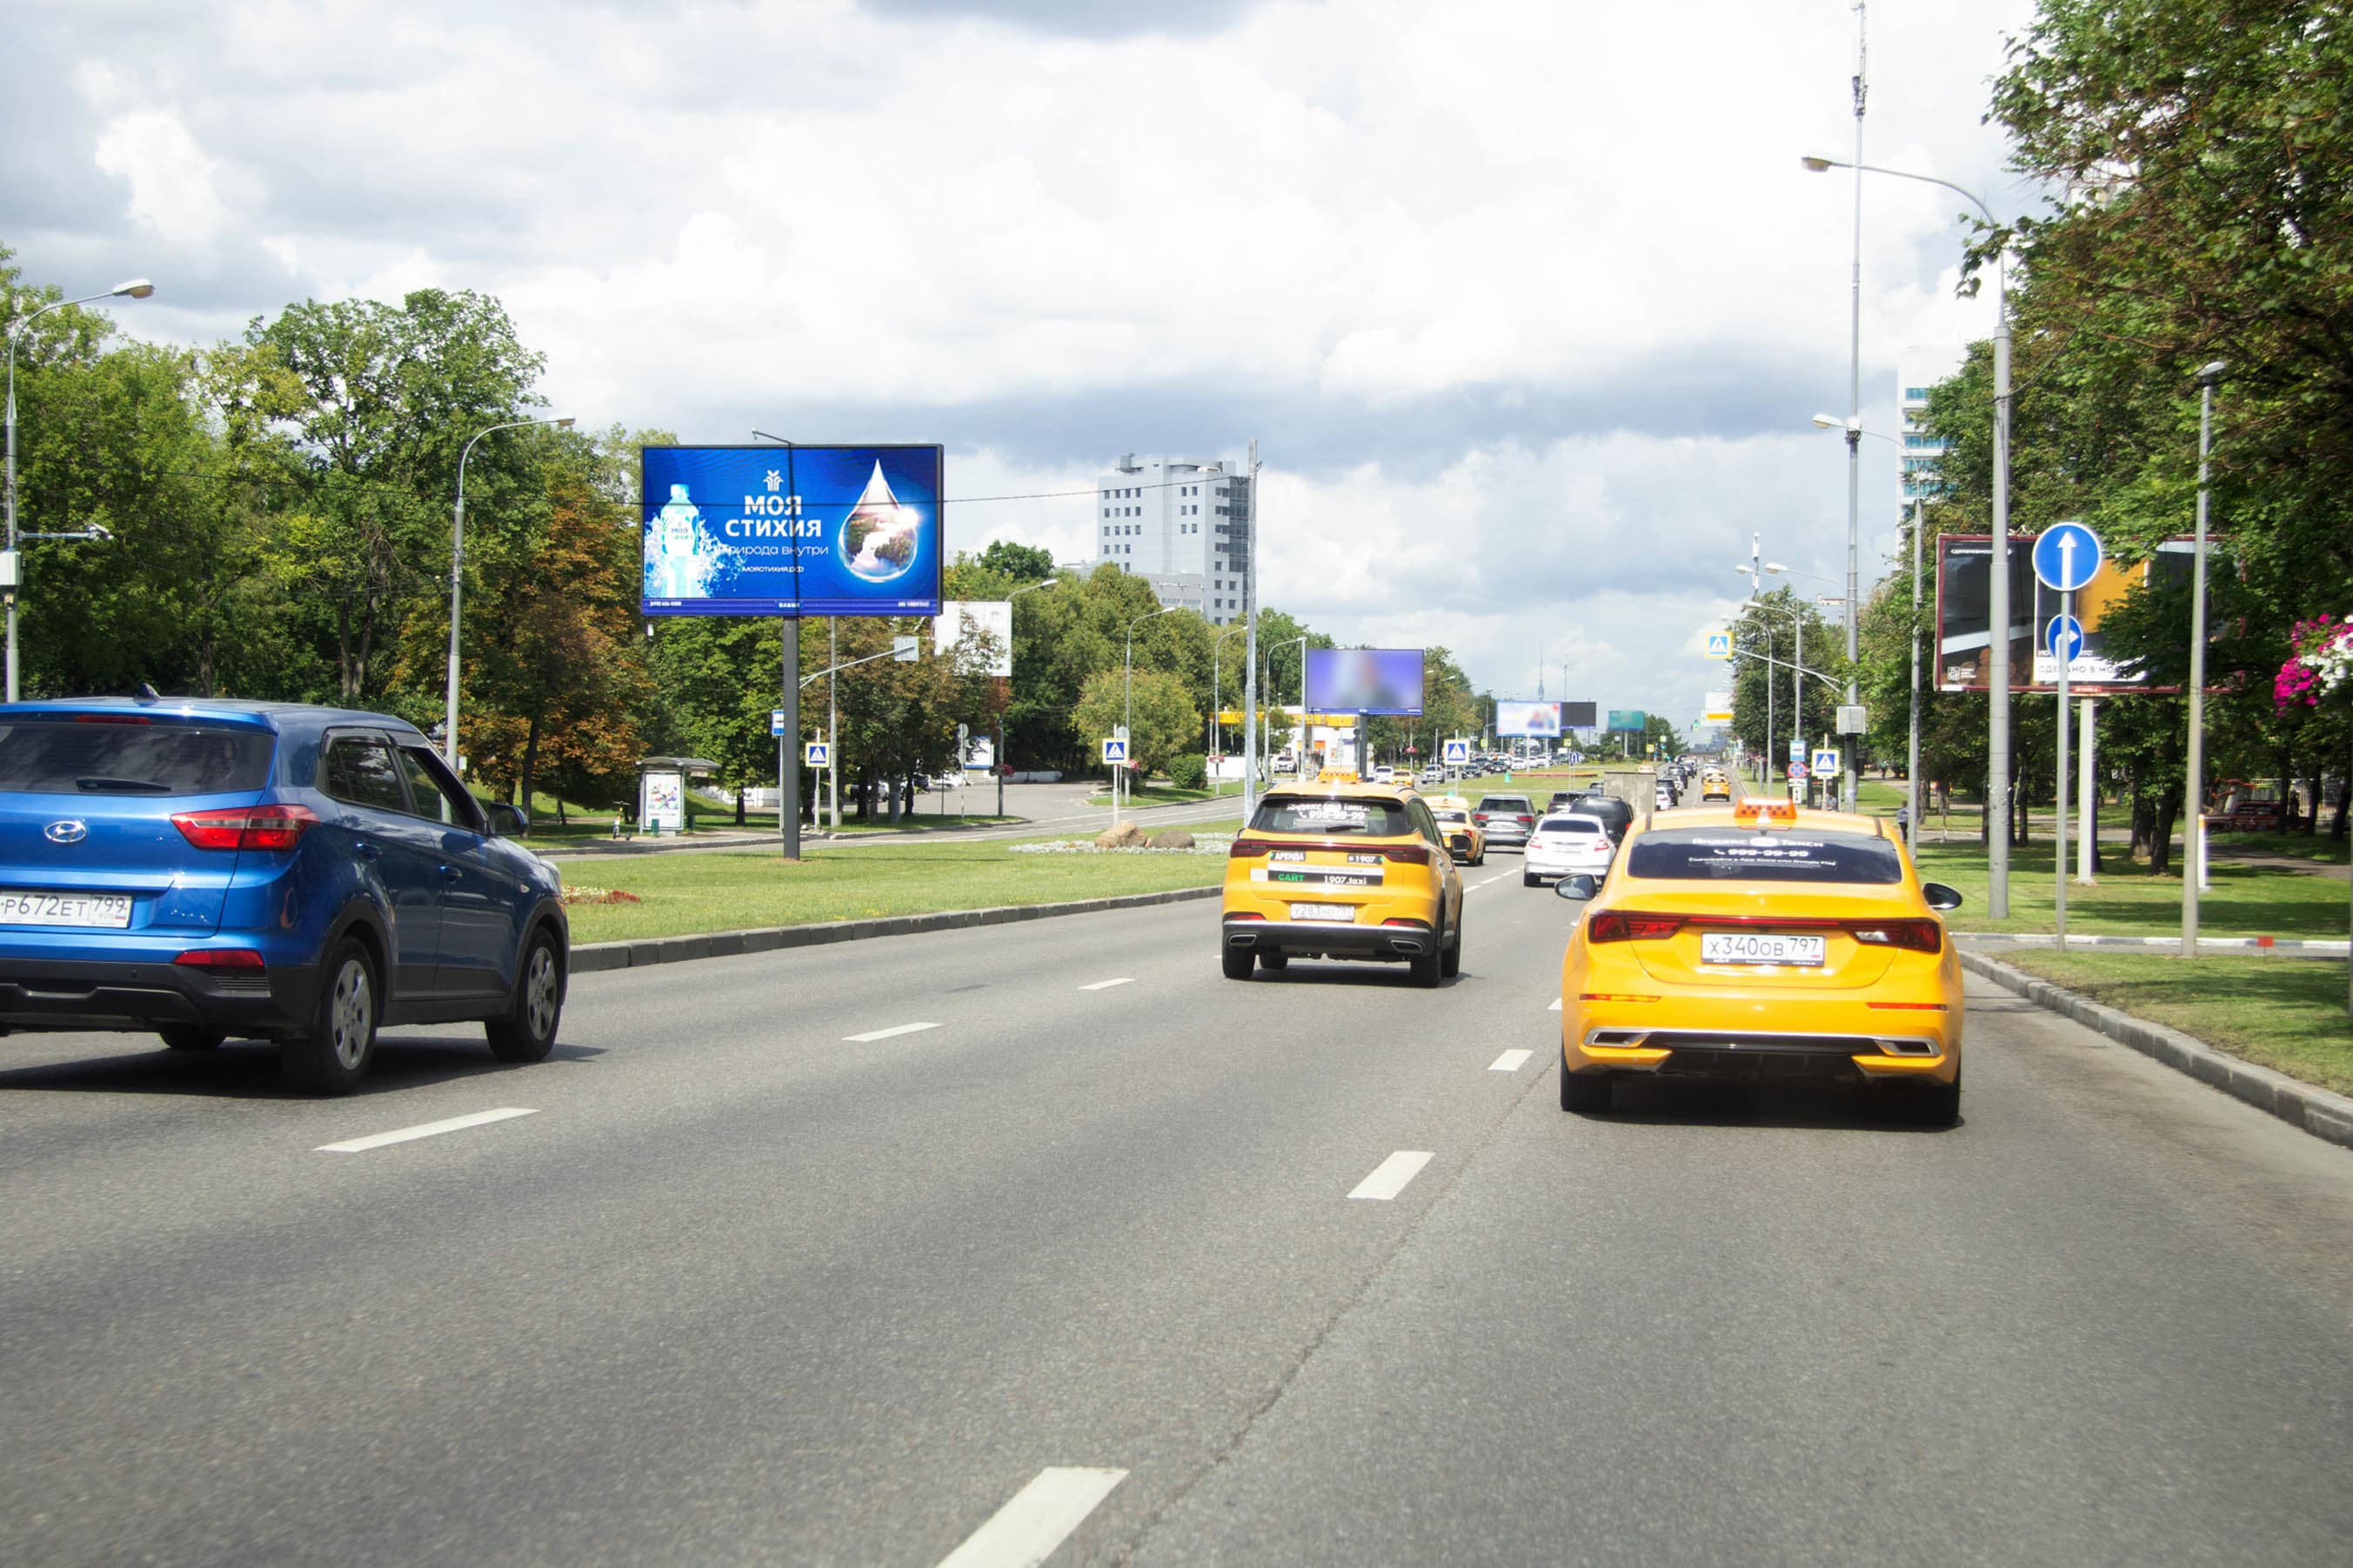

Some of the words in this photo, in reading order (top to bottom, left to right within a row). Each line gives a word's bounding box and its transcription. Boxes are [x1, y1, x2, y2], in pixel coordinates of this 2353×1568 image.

[744, 495, 802, 515] МОЯ
[725, 519, 822, 537] СТИХИЯ
[722, 545, 779, 556] рирода
[781, 545, 829, 557] внутри
[1274, 851, 1305, 862] АРЕНДА
[1355, 855, 1376, 864] 1907
[1278, 872, 1306, 882] САЙТ
[1323, 875, 1367, 885] 1907.taxi
[93, 896, 126, 913] 799
[1788, 937, 1819, 952] 797
